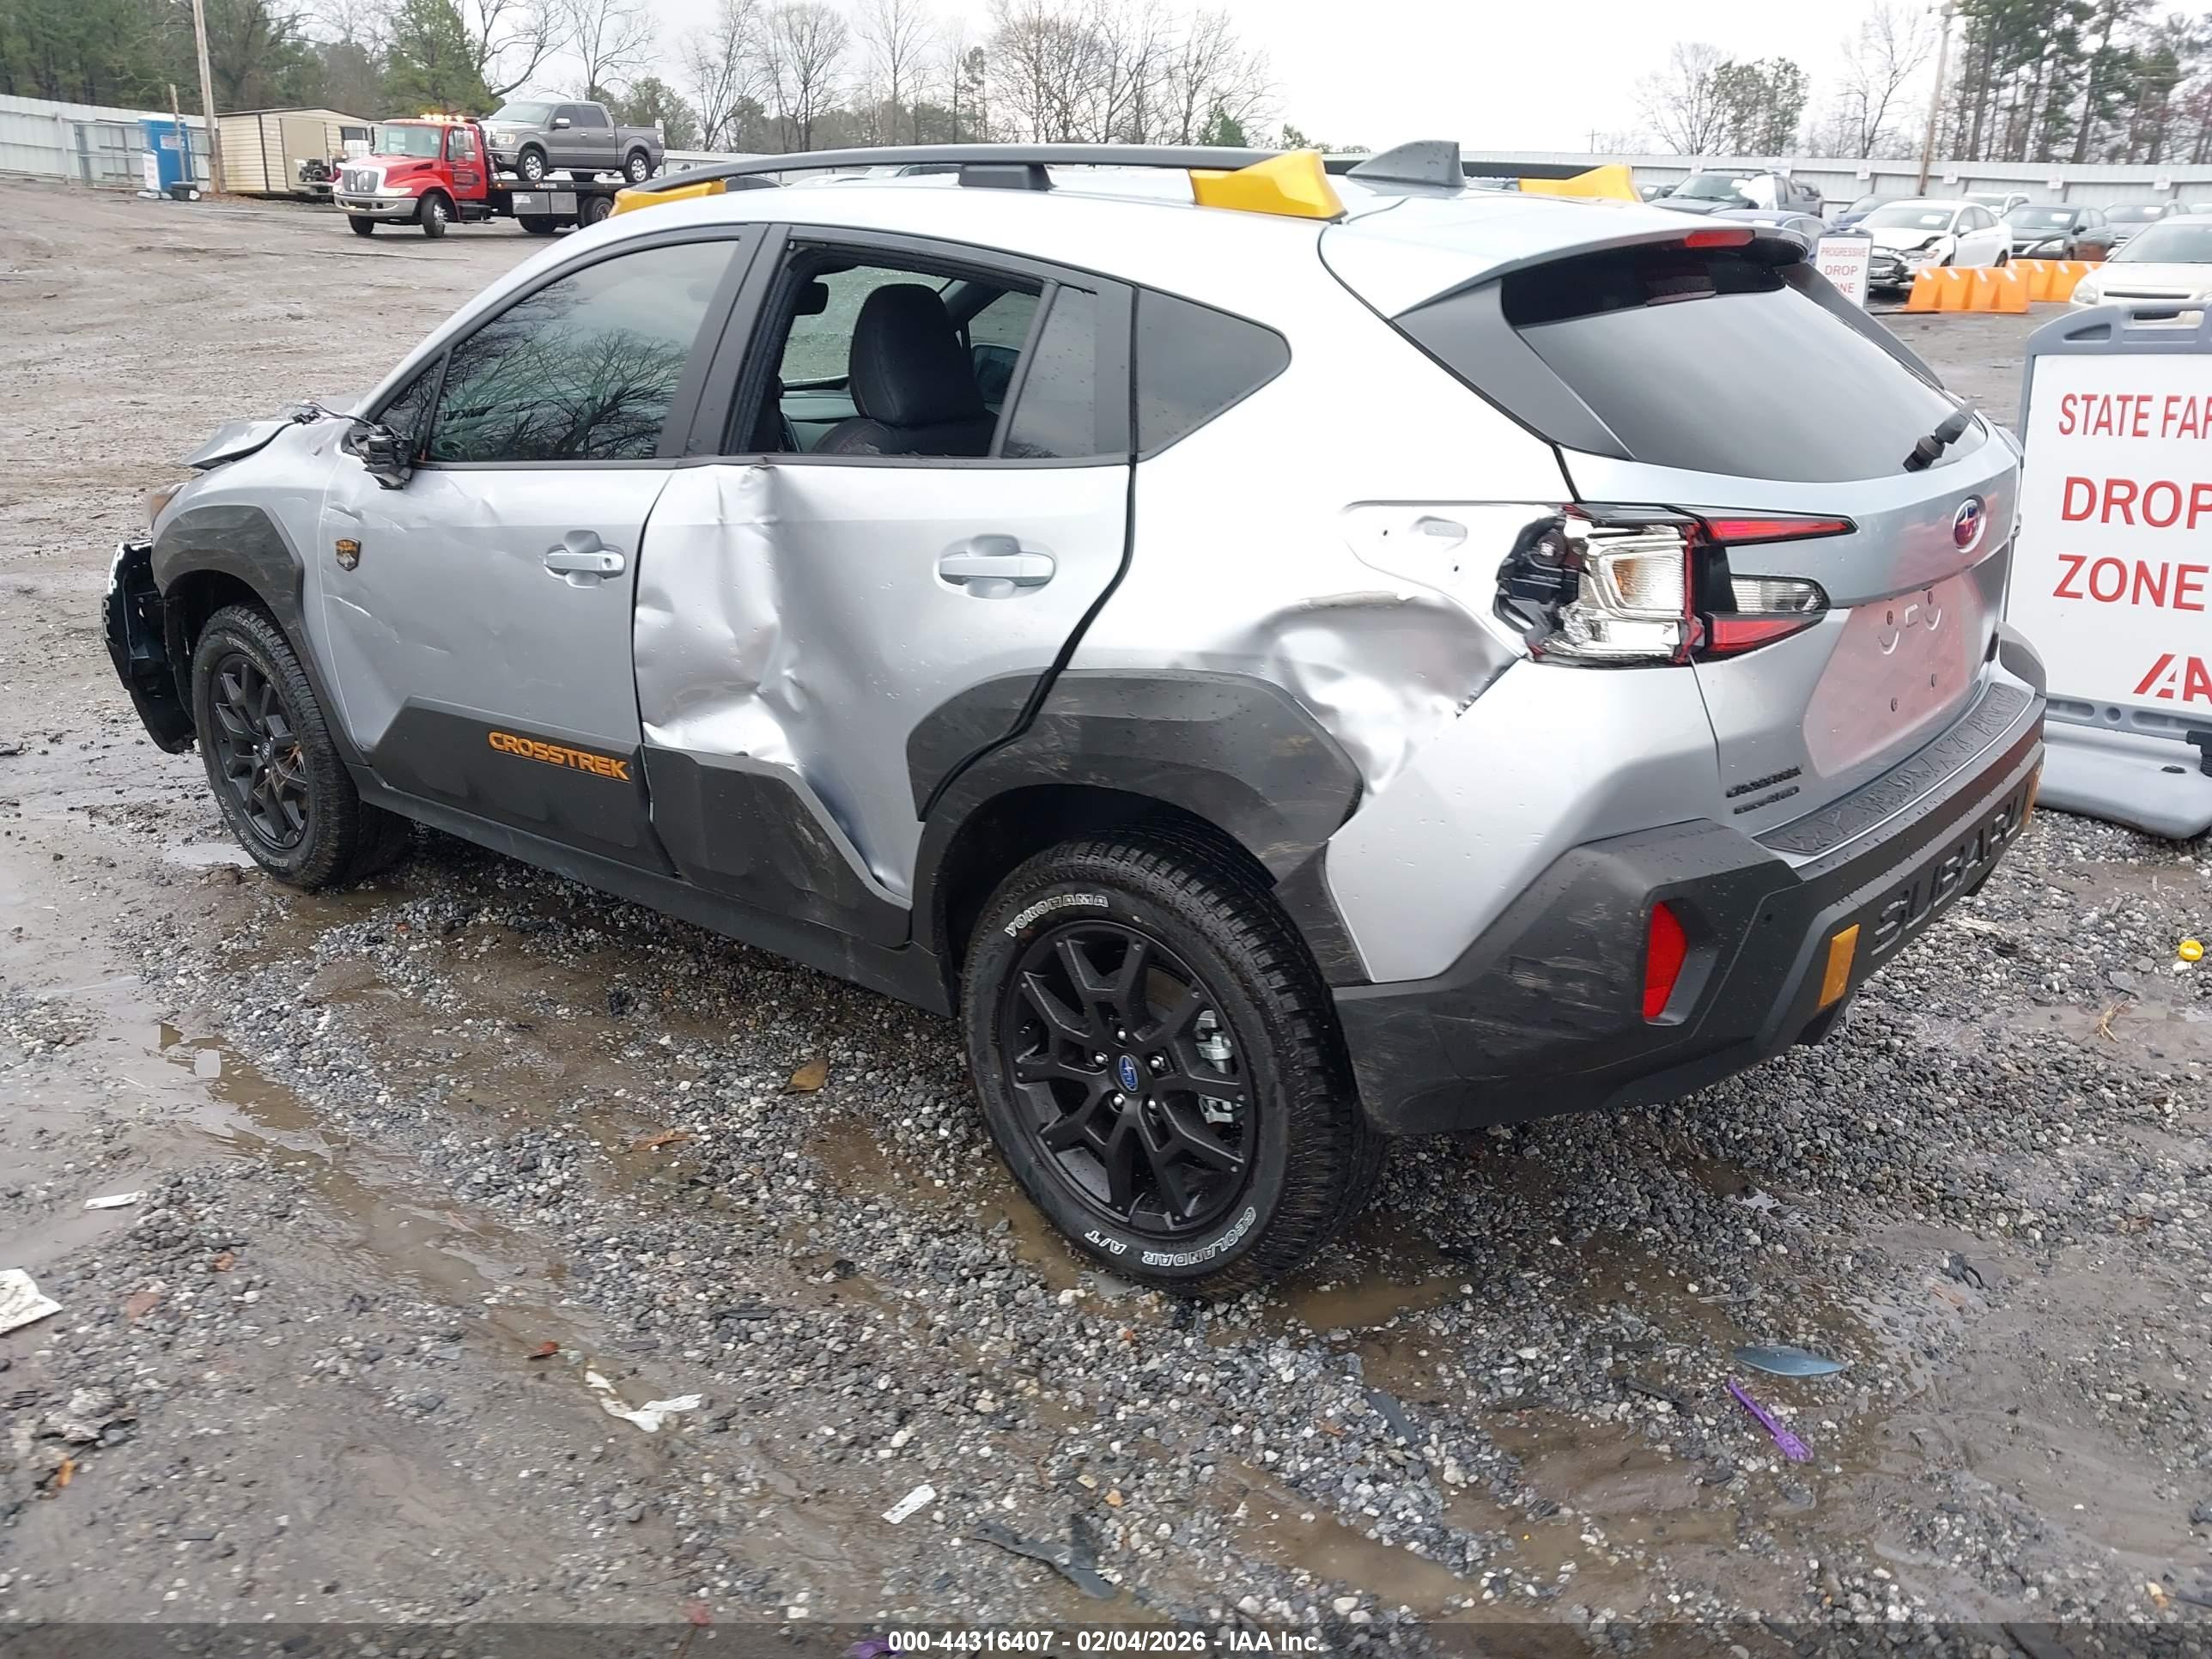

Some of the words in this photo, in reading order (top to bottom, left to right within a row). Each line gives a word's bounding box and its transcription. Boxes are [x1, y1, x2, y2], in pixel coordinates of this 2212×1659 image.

[1824, 264, 1858, 276] DROP
[2058, 392, 2154, 437] STATE
[2062, 476, 2212, 530] DROP
[2053, 554, 2210, 611] ZONE
[488, 732, 630, 781] CROSSTREK
[1004, 894, 1109, 937] YOKOHAMA
[1085, 1230, 1127, 1255] A/T
[1141, 1206, 1256, 1267] GEOLANDAR
